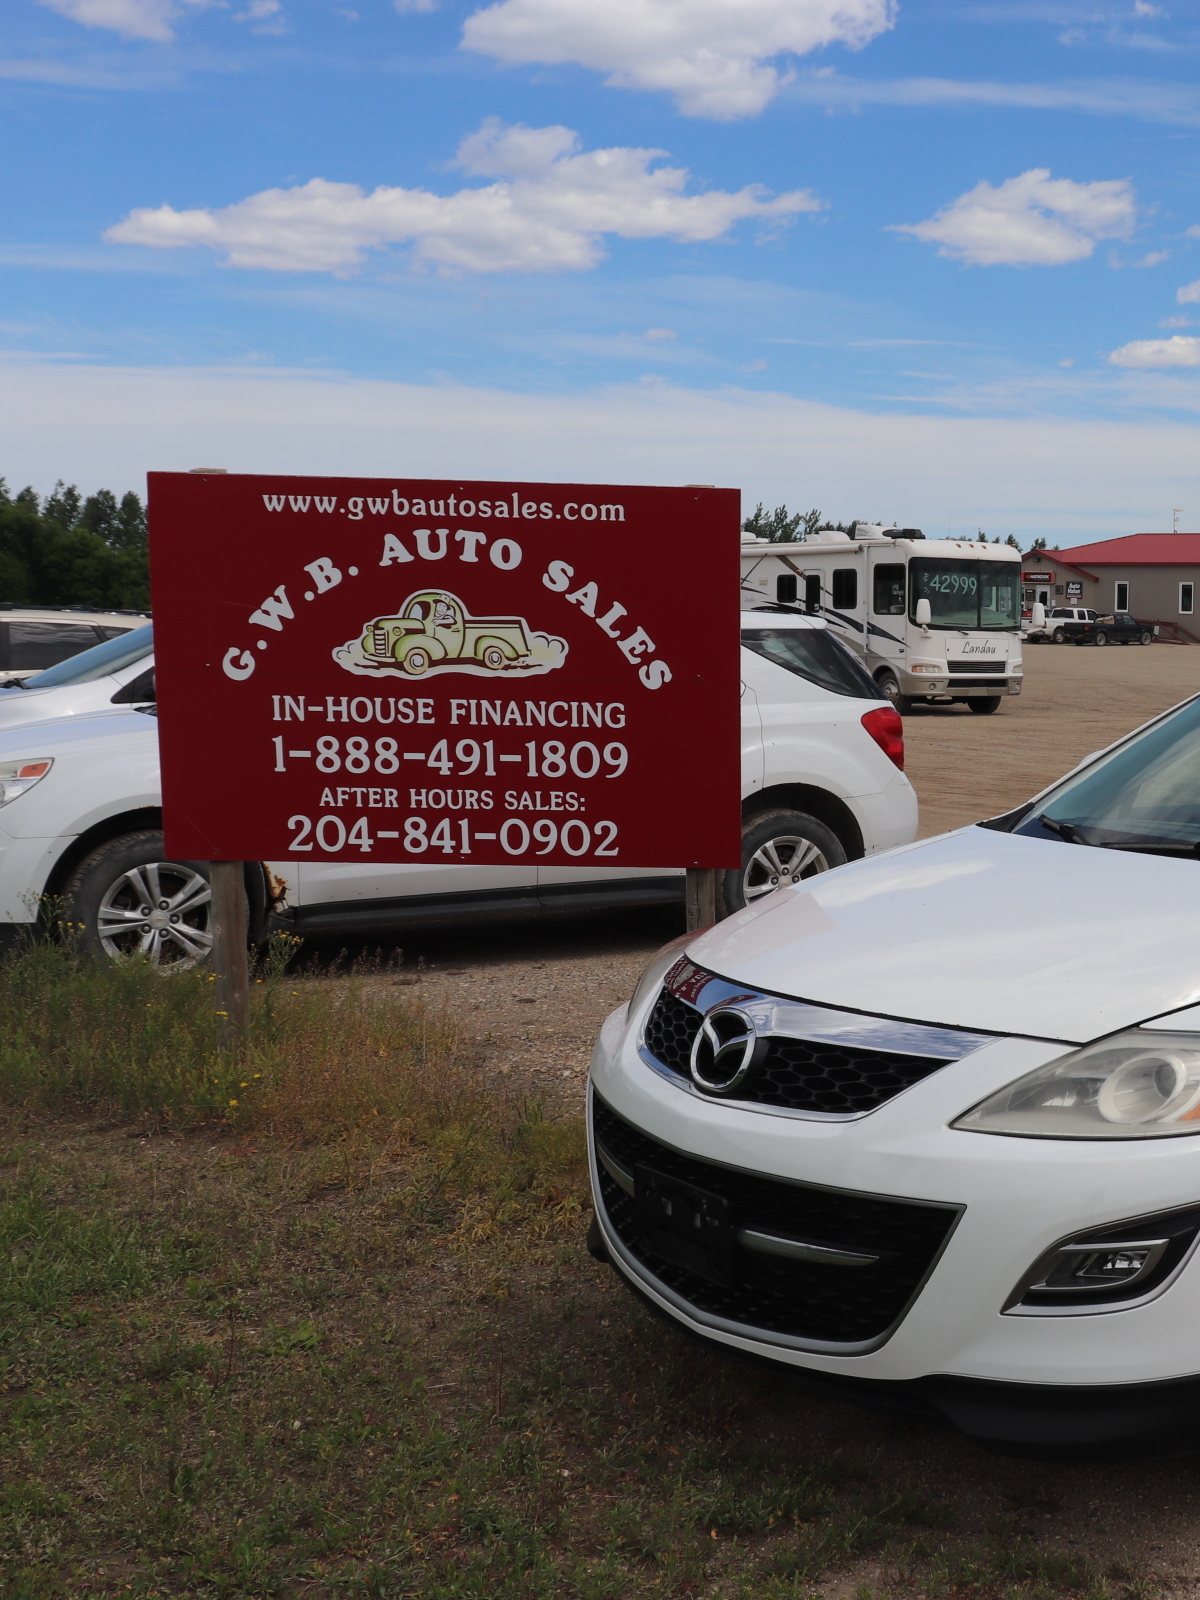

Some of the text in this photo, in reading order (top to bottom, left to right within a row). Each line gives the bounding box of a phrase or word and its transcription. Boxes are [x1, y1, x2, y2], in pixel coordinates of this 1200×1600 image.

[262, 488, 626, 522] www.gwbautosales.com
[222, 528, 673, 690] G.W.B. AUTO SALES
[961, 639, 996, 654] Landau
[271, 694, 627, 729] IN-HOUSE FINANCING
[271, 735, 629, 779] 1-888-491-1809
[319, 786, 586, 812] AFTER HOURS SALES:
[287, 814, 619, 859] 204-841-0902
